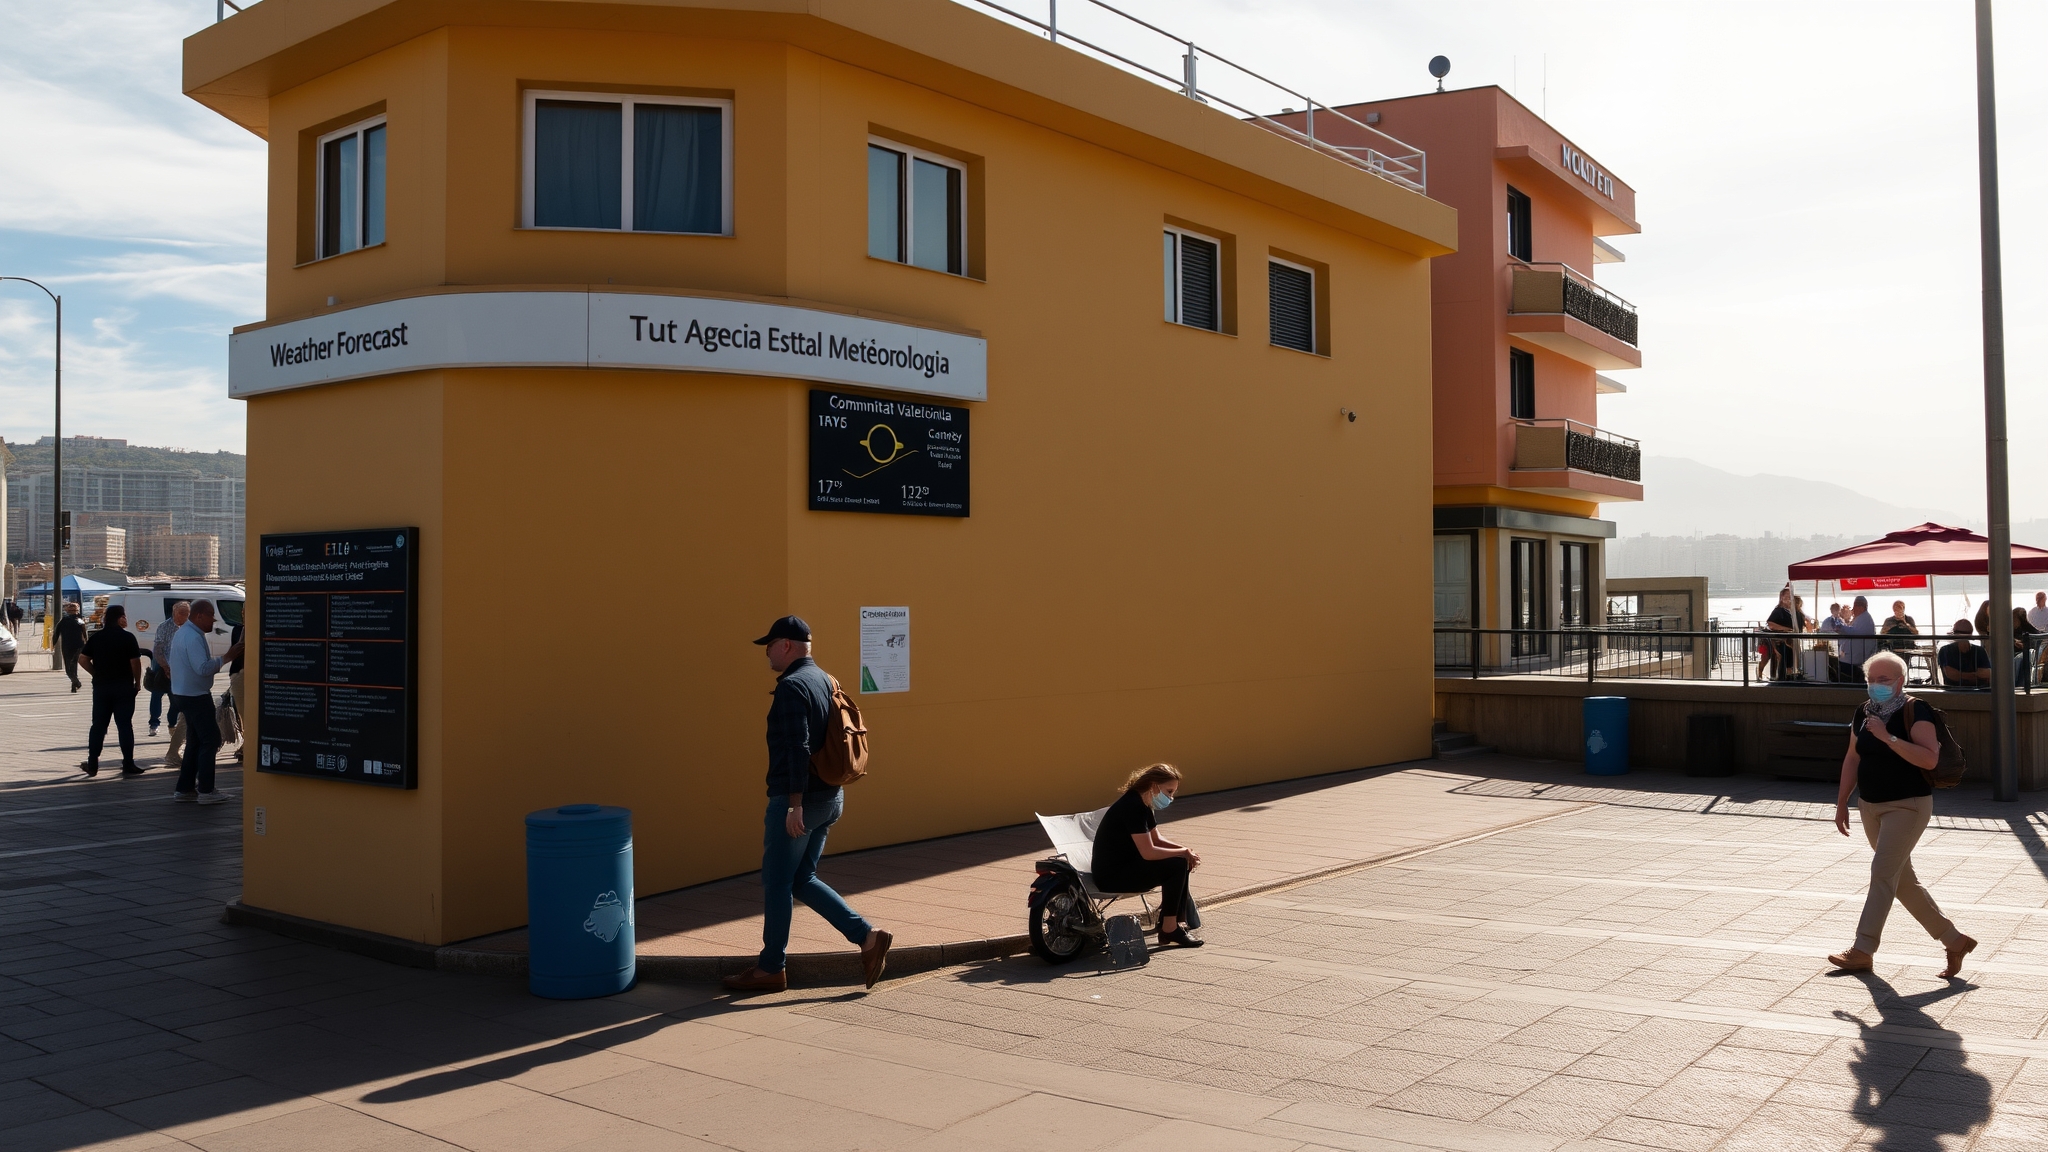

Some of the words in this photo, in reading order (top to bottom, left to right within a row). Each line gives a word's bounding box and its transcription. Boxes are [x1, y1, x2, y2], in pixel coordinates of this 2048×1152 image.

[270, 337, 334, 367] Weather
[337, 322, 408, 356] Forecast
[629, 315, 678, 343] Tut
[684, 319, 761, 352] Agecia
[768, 327, 822, 357] Esttal
